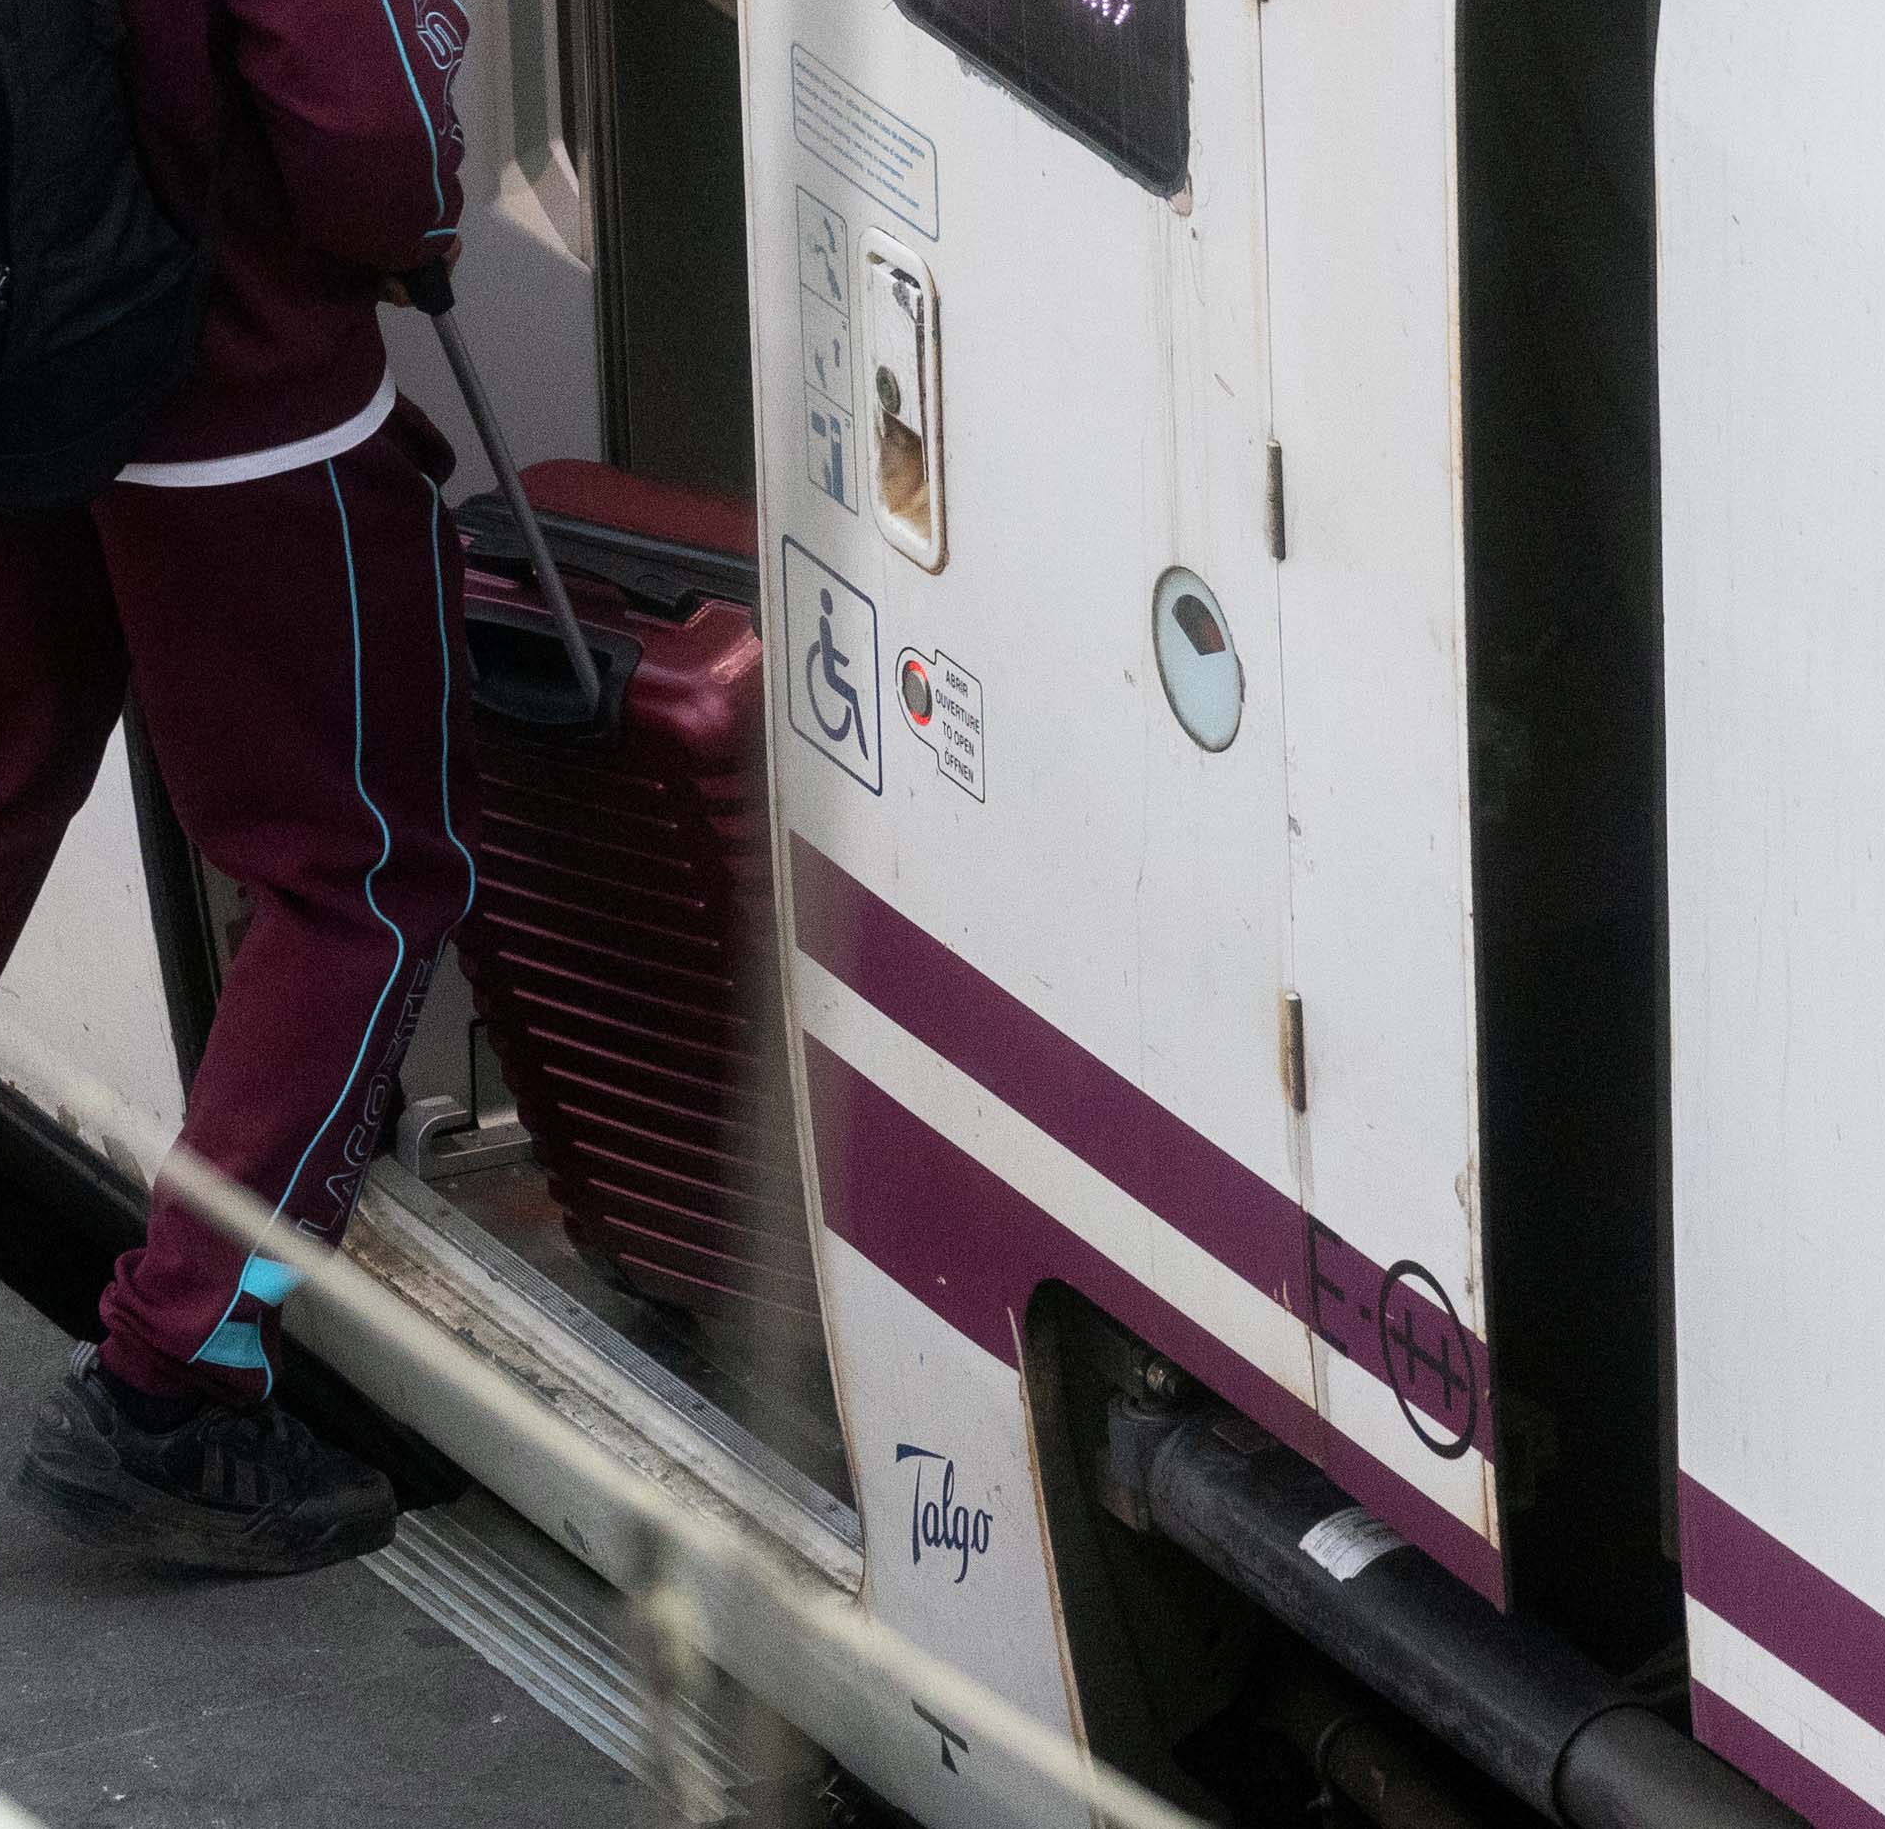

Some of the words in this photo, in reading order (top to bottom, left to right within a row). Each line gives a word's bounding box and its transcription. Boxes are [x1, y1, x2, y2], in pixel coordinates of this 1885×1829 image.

[945, 670, 969, 698] ABRIR
[935, 689, 980, 735] OUVERTURE
[942, 721, 953, 740] TO
[954, 731, 975, 757] OPEN
[895, 1443, 994, 1584] Talgo
